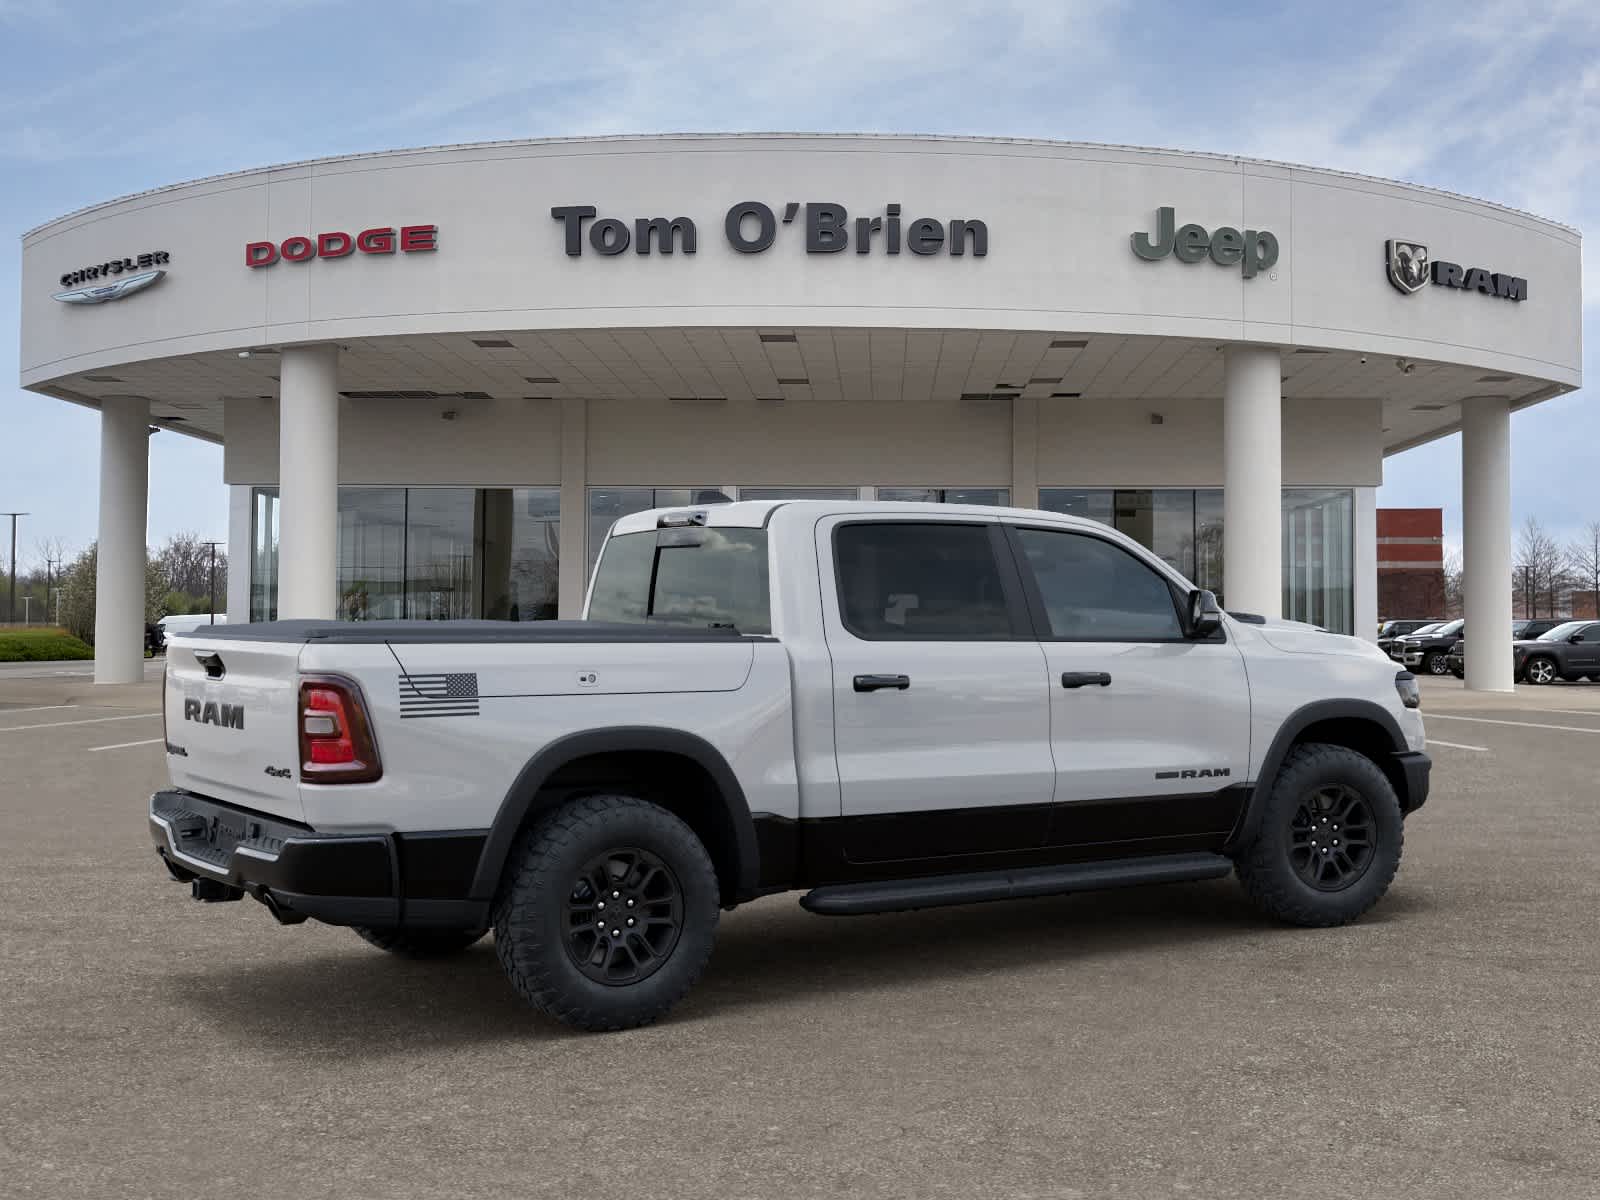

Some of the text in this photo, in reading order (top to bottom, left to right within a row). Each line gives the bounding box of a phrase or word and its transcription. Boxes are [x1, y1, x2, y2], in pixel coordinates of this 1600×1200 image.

[245, 224, 438, 269] DODGE
[551, 201, 988, 256] Tom O'Brien
[1130, 206, 1280, 279] Jeep
[60, 250, 170, 287] CHRYSLER
[1430, 261, 1528, 302] RAM
[184, 698, 245, 730] RAM
[1181, 767, 1231, 779] RAM
